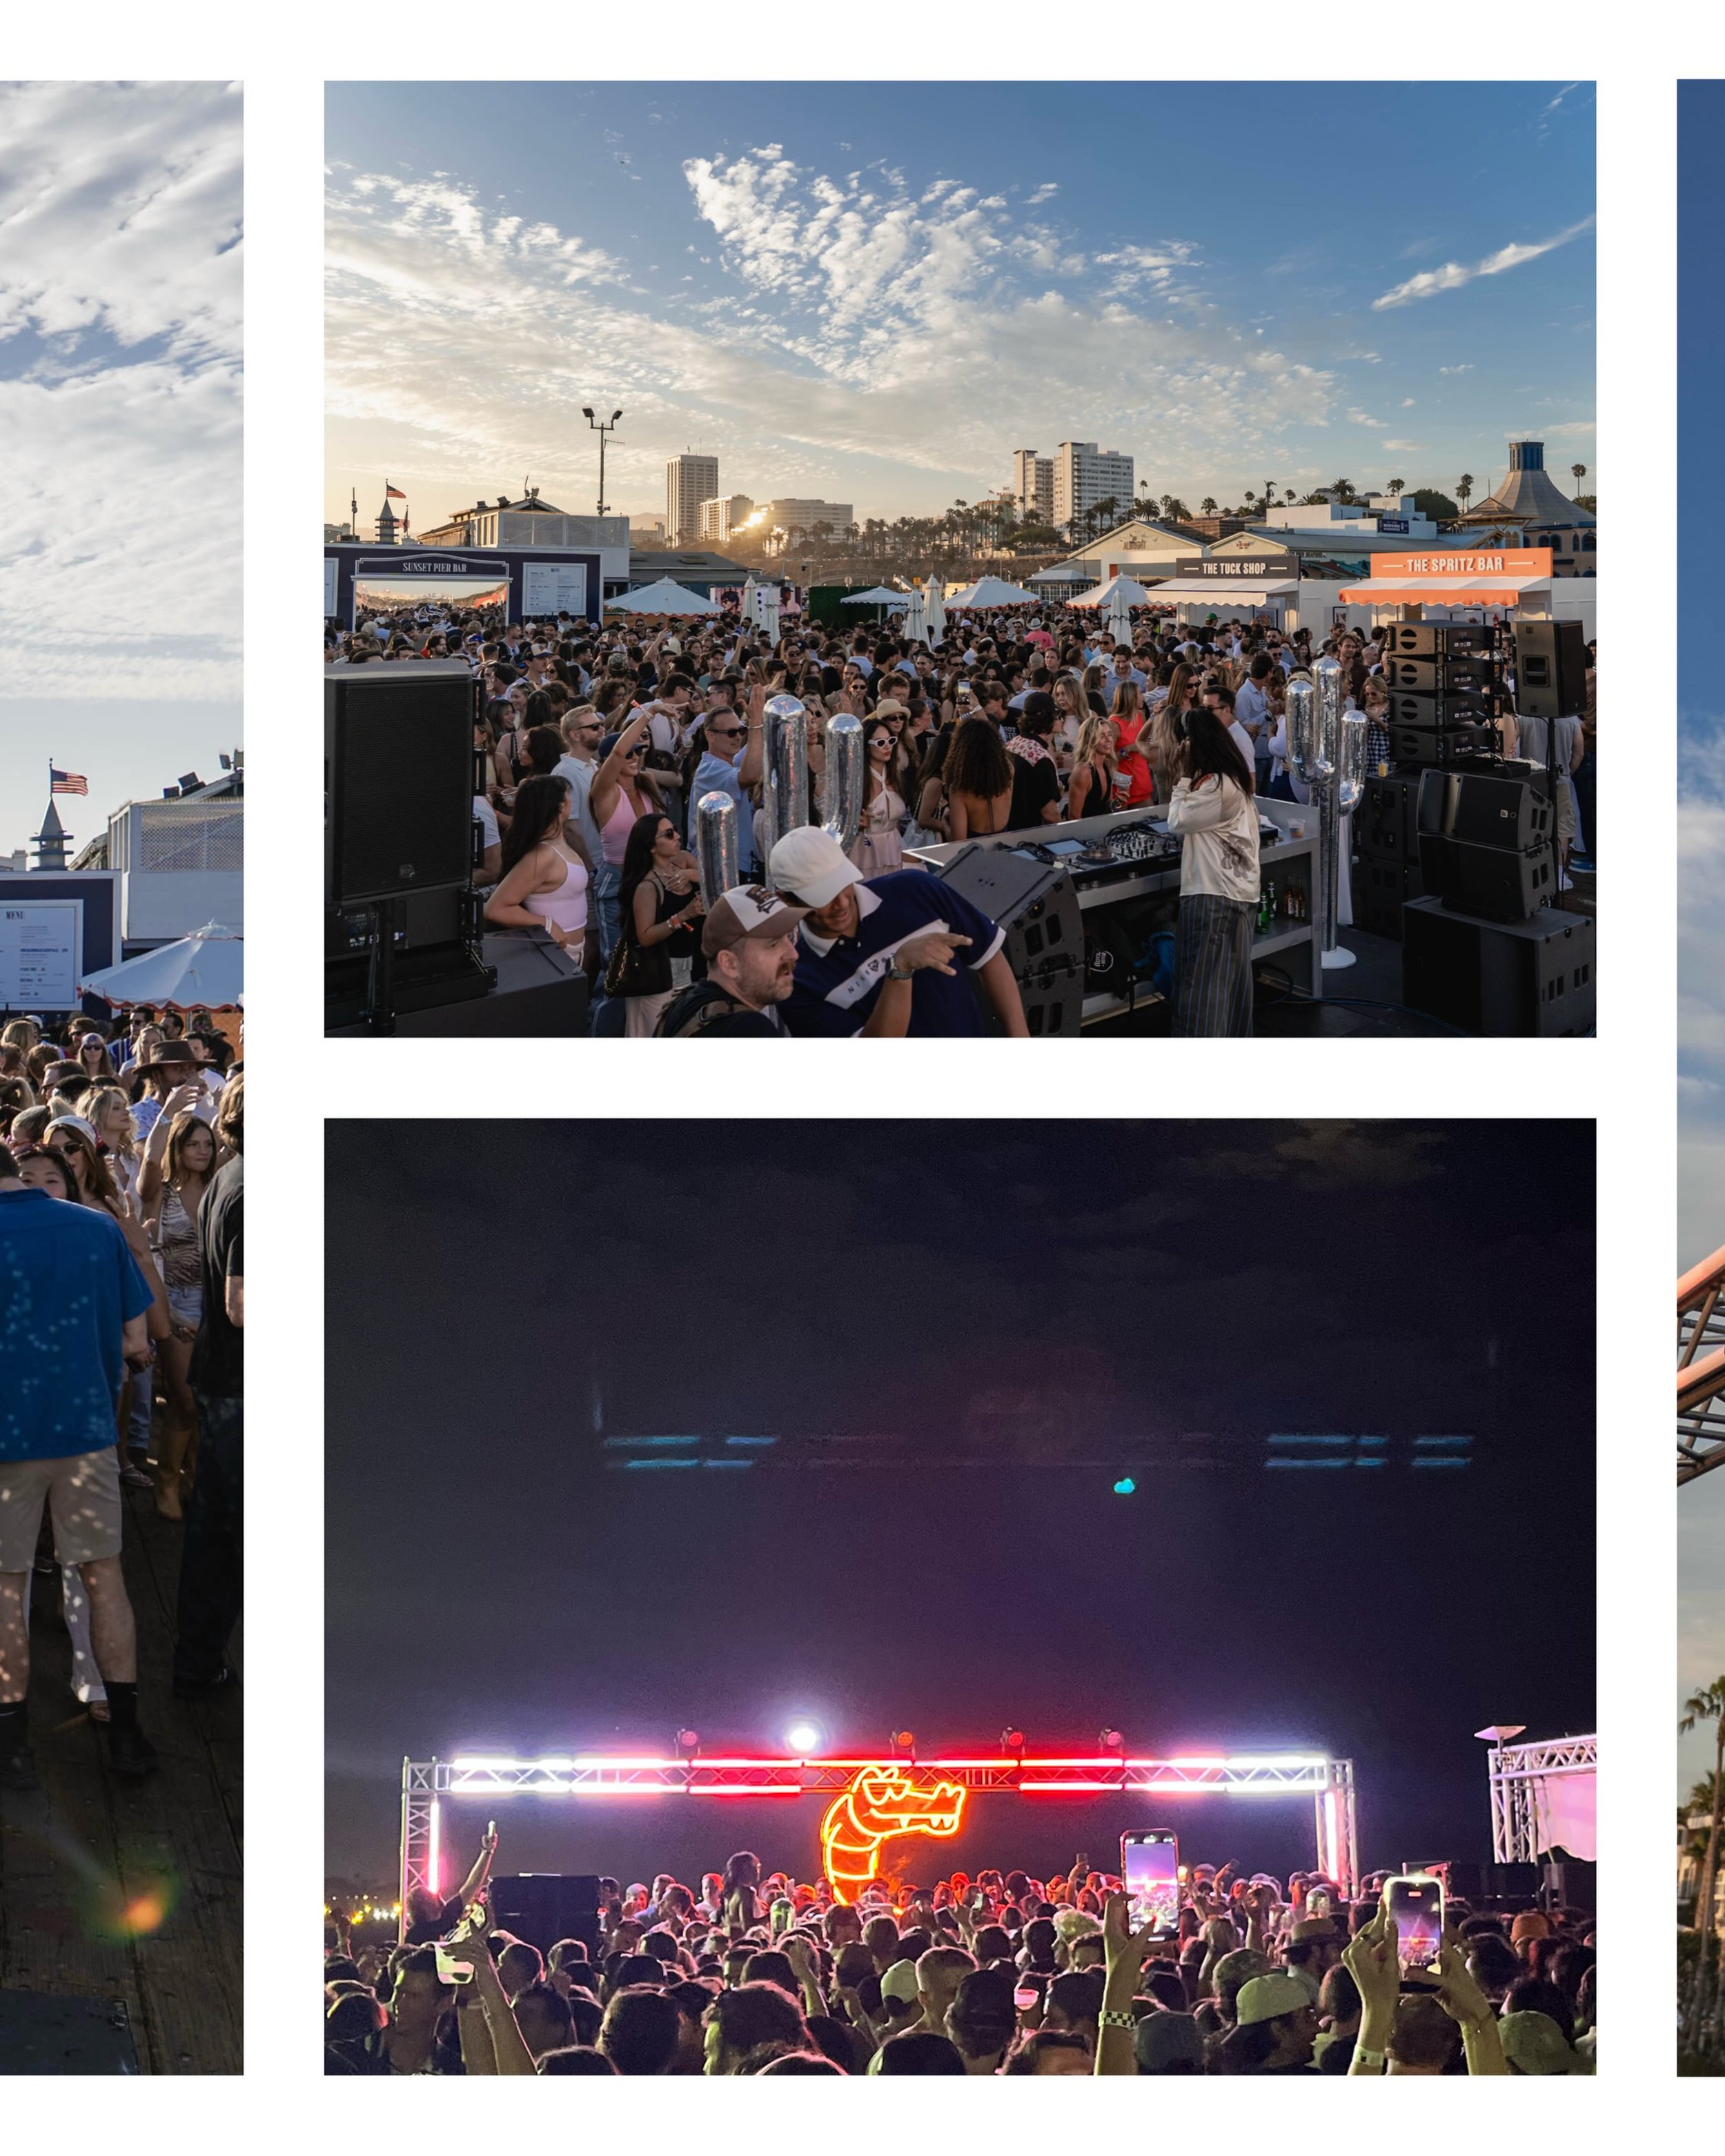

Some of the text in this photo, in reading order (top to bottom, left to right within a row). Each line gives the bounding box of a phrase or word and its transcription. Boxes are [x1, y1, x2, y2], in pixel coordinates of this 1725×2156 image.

[403, 562, 467, 573] SUNSET PIER BAR
[1203, 562, 1266, 574] THE TUCK SHOP
[1407, 556, 1504, 572] THE SPRITZ BAR
[848, 969, 870, 993] NIKE
